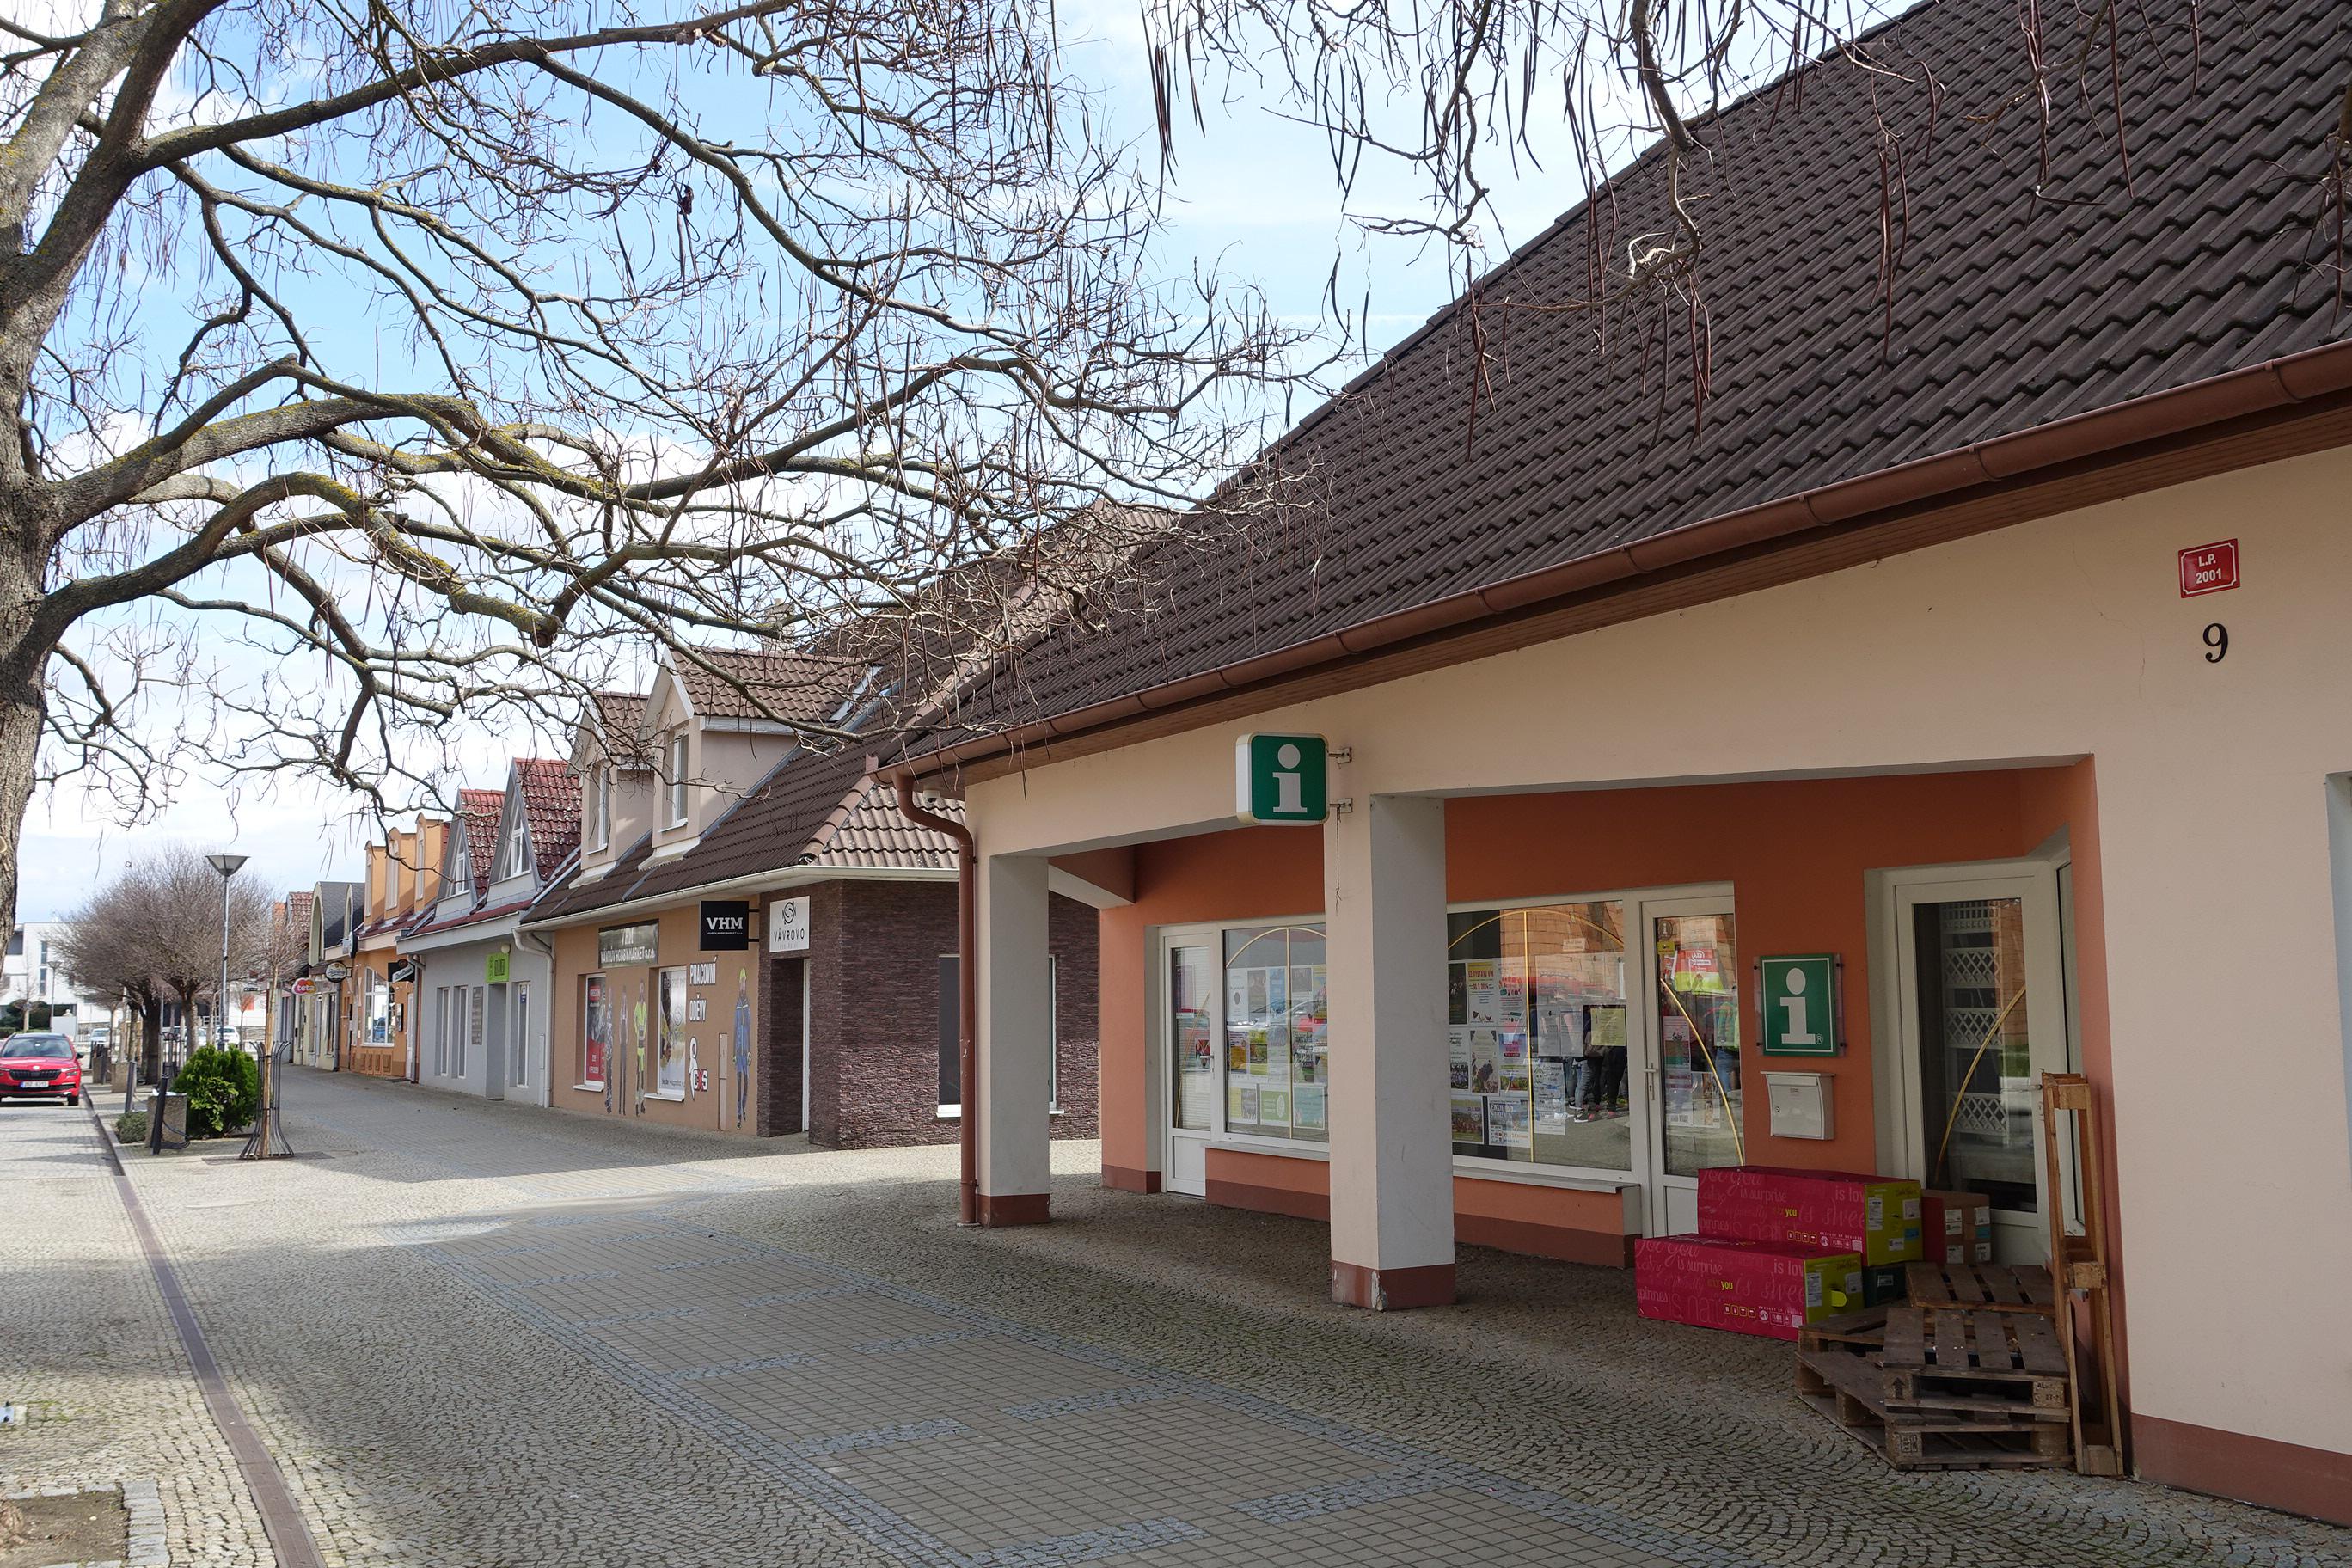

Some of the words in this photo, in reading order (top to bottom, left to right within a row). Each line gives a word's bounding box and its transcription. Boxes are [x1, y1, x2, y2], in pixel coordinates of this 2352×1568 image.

[2198, 554, 2216, 567] L.P.
[2196, 568, 2222, 584] 2001
[2202, 623, 2228, 663] 9
[706, 917, 743, 930] VHM
[774, 928, 805, 942] VÁVROVO
[689, 957, 718, 985] PRACOVNÍ
[689, 993, 707, 1022] ODĚVY
[1749, 1187, 1788, 1204] surprise
[1835, 1185, 1846, 1201] is
[1785, 1209, 1798, 1218] you
[1687, 1259, 1724, 1277] surprise
[1773, 1259, 1785, 1275] is
[1721, 1280, 1734, 1290] you
